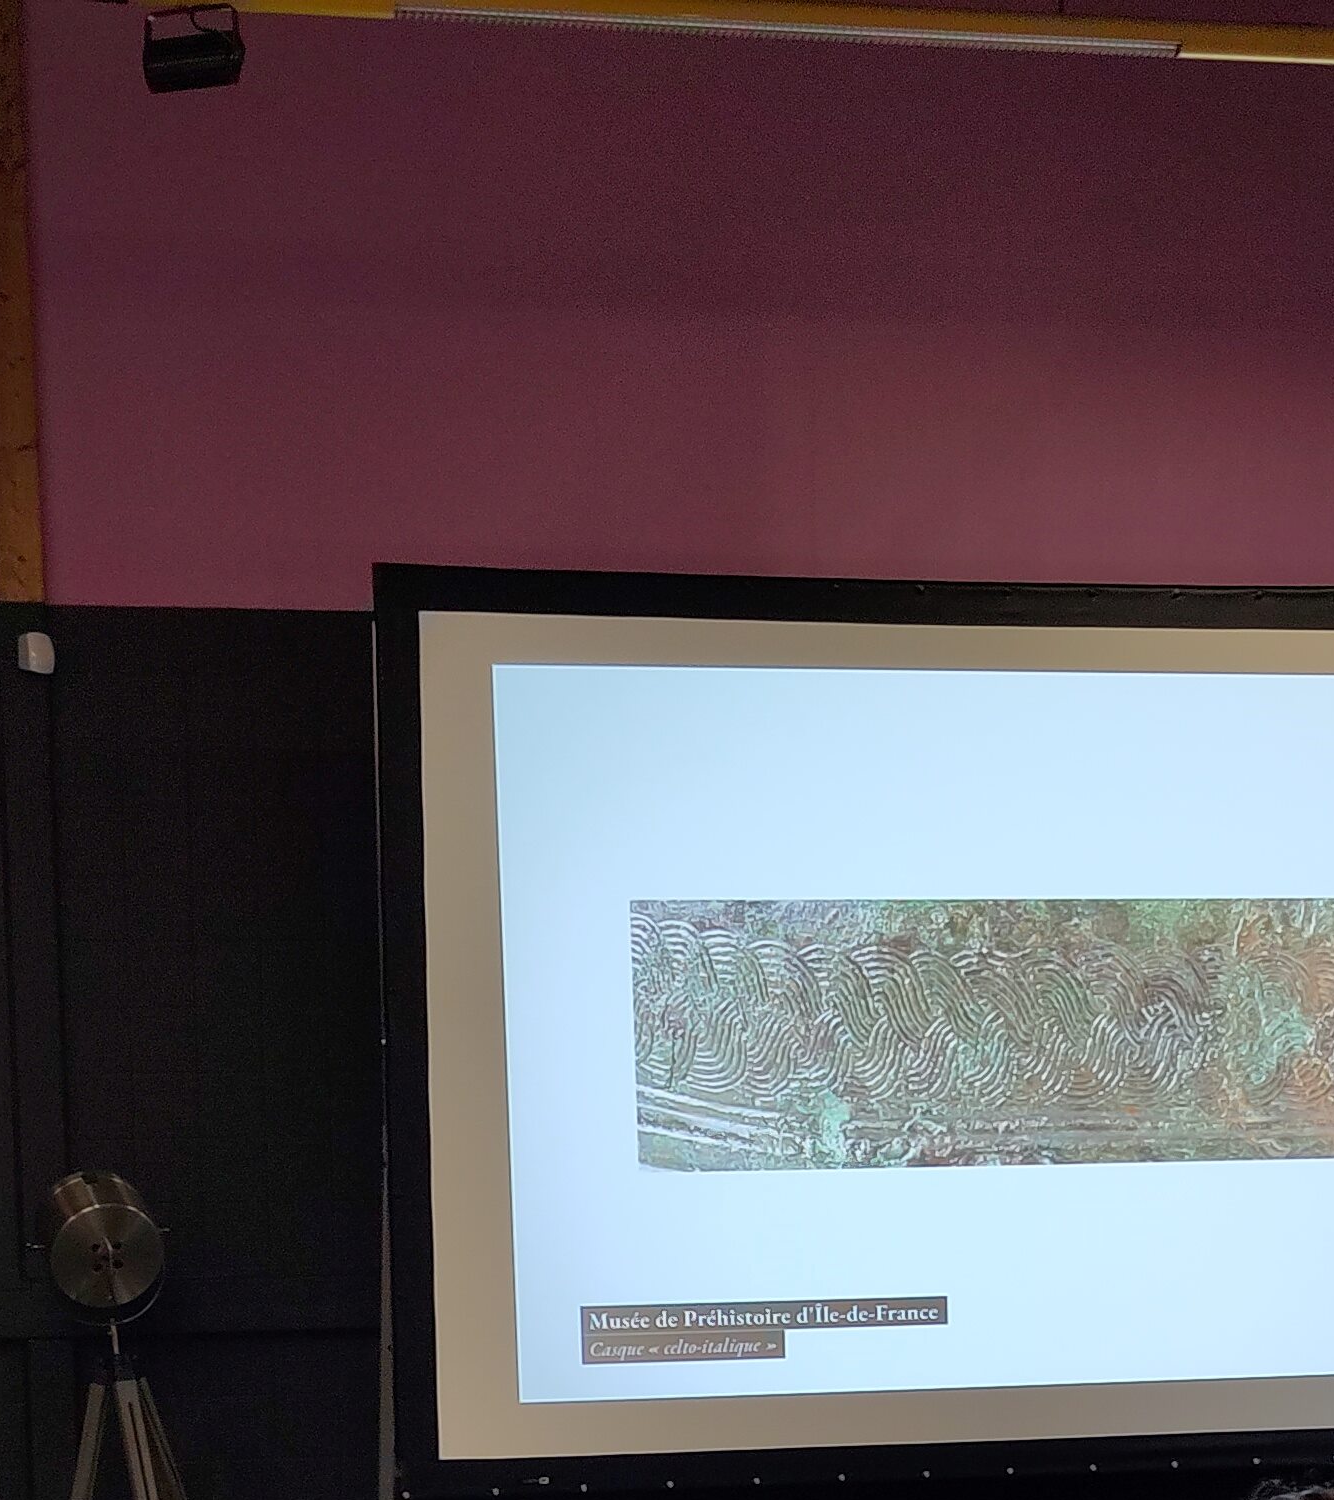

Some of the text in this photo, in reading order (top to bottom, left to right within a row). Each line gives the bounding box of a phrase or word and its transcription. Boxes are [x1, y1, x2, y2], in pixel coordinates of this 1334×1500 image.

[589, 1302, 939, 1331] Musée de Préhistoire d'Île-de-France
[589, 1341, 643, 1361] Casque
[663, 1336, 761, 1358] celto-italique
